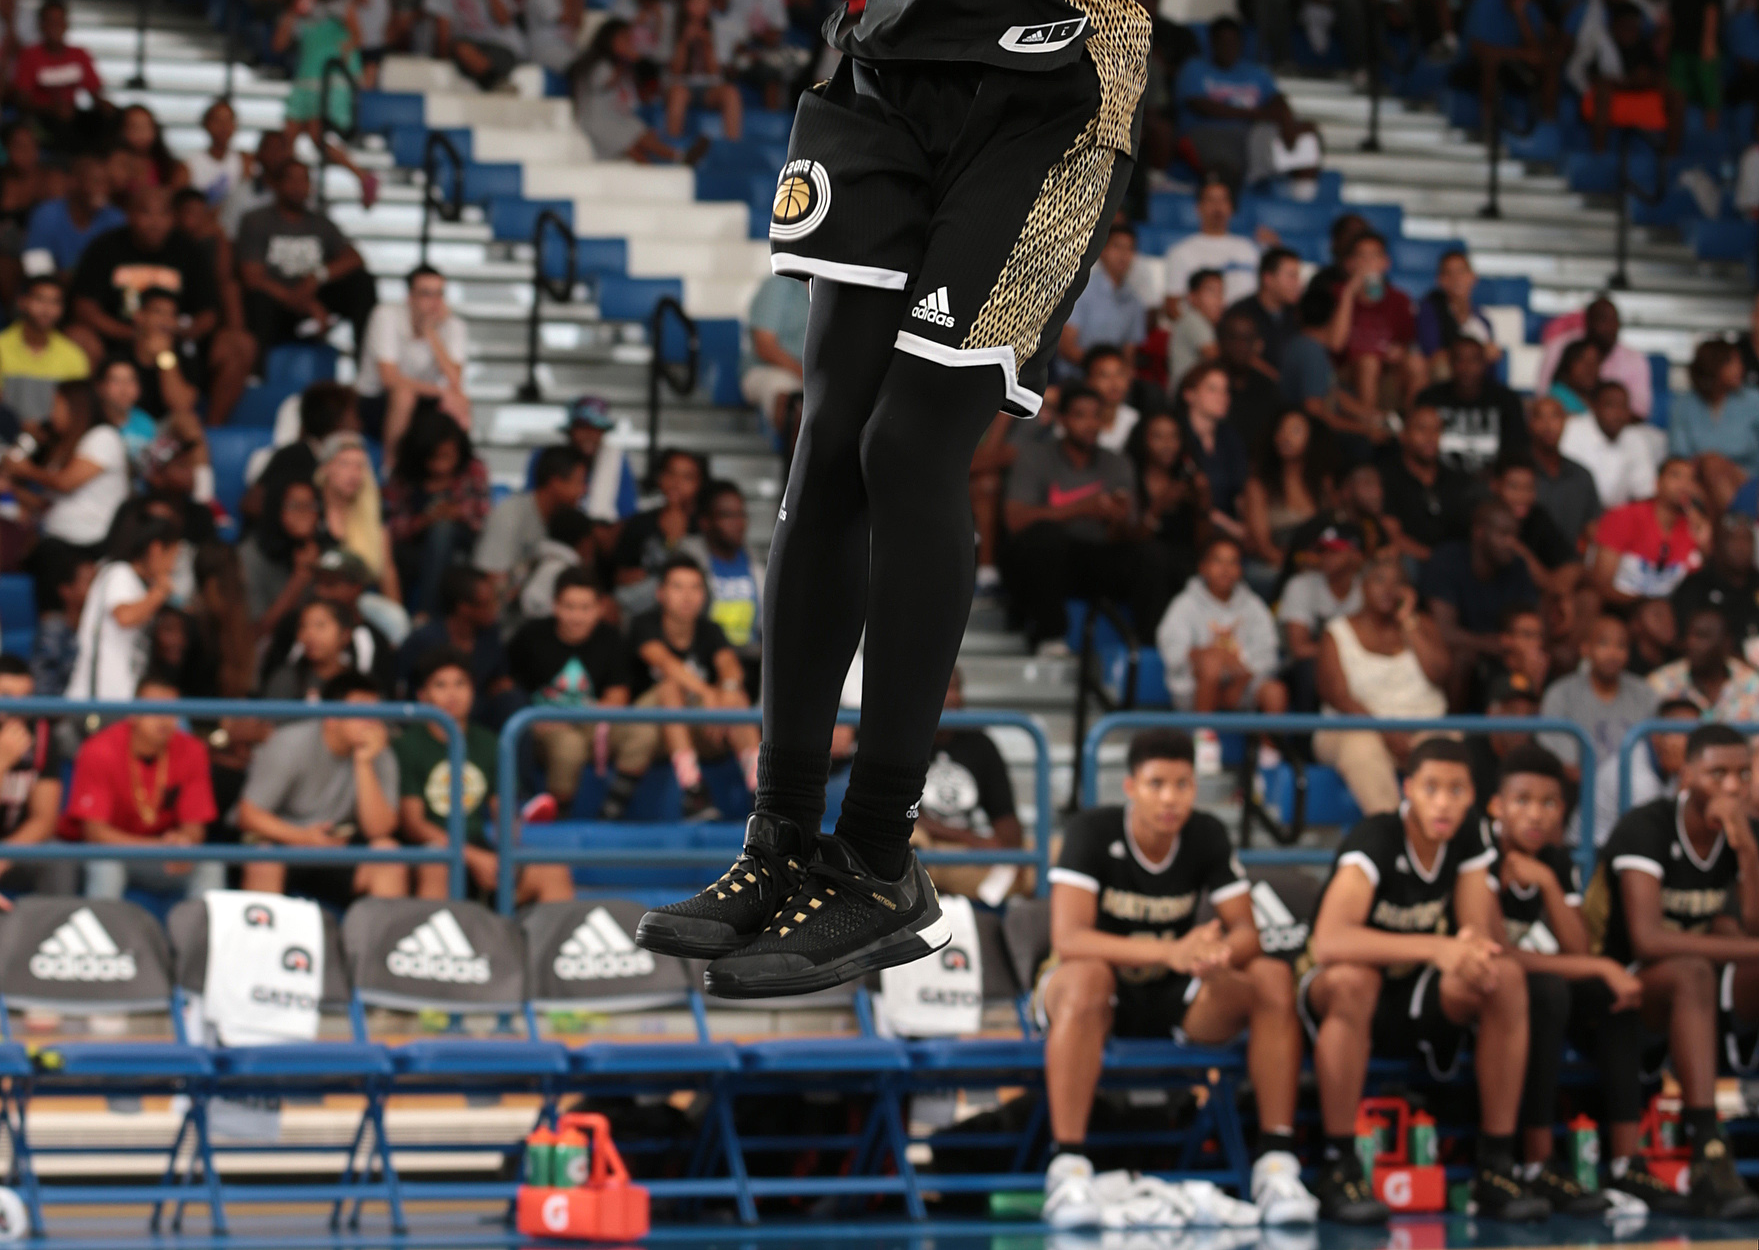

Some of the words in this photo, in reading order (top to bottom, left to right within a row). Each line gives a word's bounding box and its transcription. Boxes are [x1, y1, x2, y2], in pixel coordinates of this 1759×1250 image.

[785, 159, 812, 177] 2015
[911, 305, 956, 328] adidas
[872, 892, 897, 911] NATIONS
[29, 950, 137, 981] adidas
[386, 950, 491, 984] adidas
[553, 950, 655, 980] adidas
[1382, 1170, 1412, 1207] G
[542, 1193, 570, 1232] G
